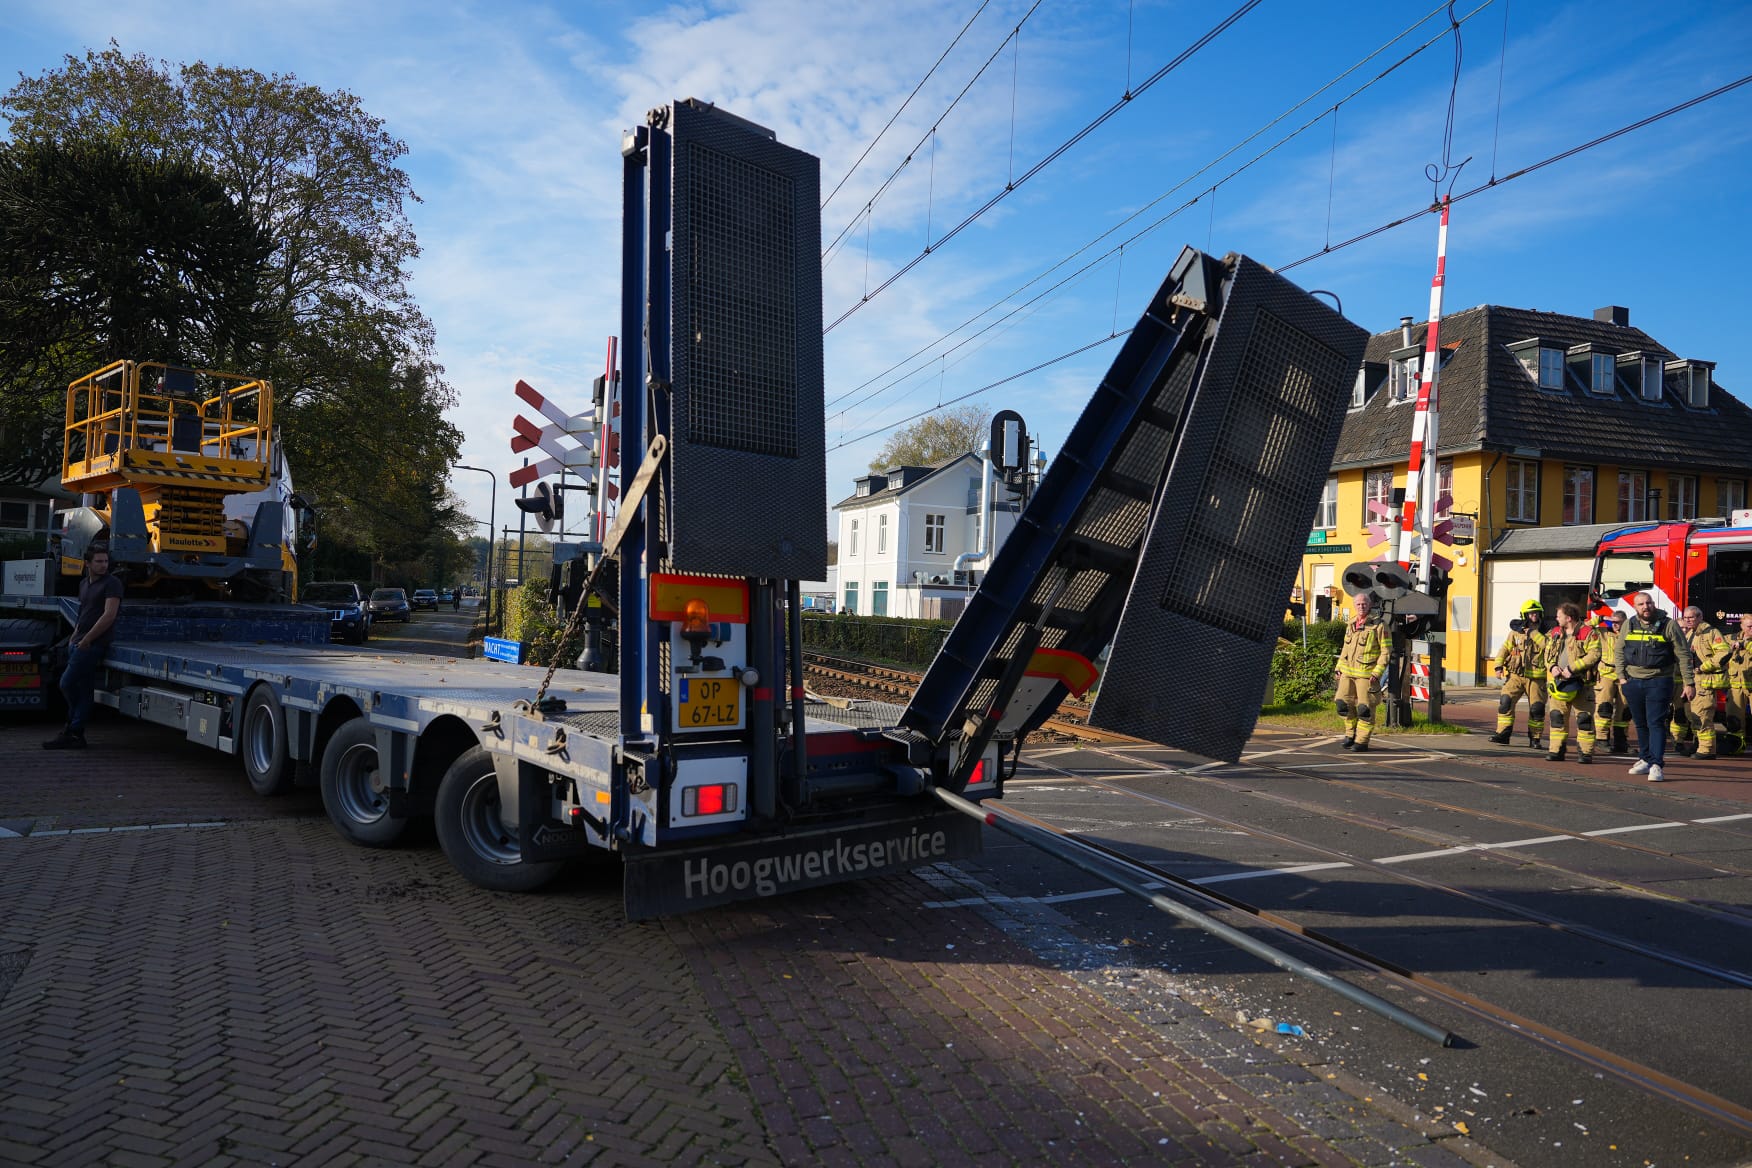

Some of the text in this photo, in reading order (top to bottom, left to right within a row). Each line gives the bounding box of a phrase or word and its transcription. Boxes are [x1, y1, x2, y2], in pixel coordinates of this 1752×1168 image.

[169, 536, 203, 546] Haulotte
[700, 681, 721, 700] OP
[692, 704, 735, 724] 67-LZ
[684, 826, 946, 900] Hoogwerkservice
